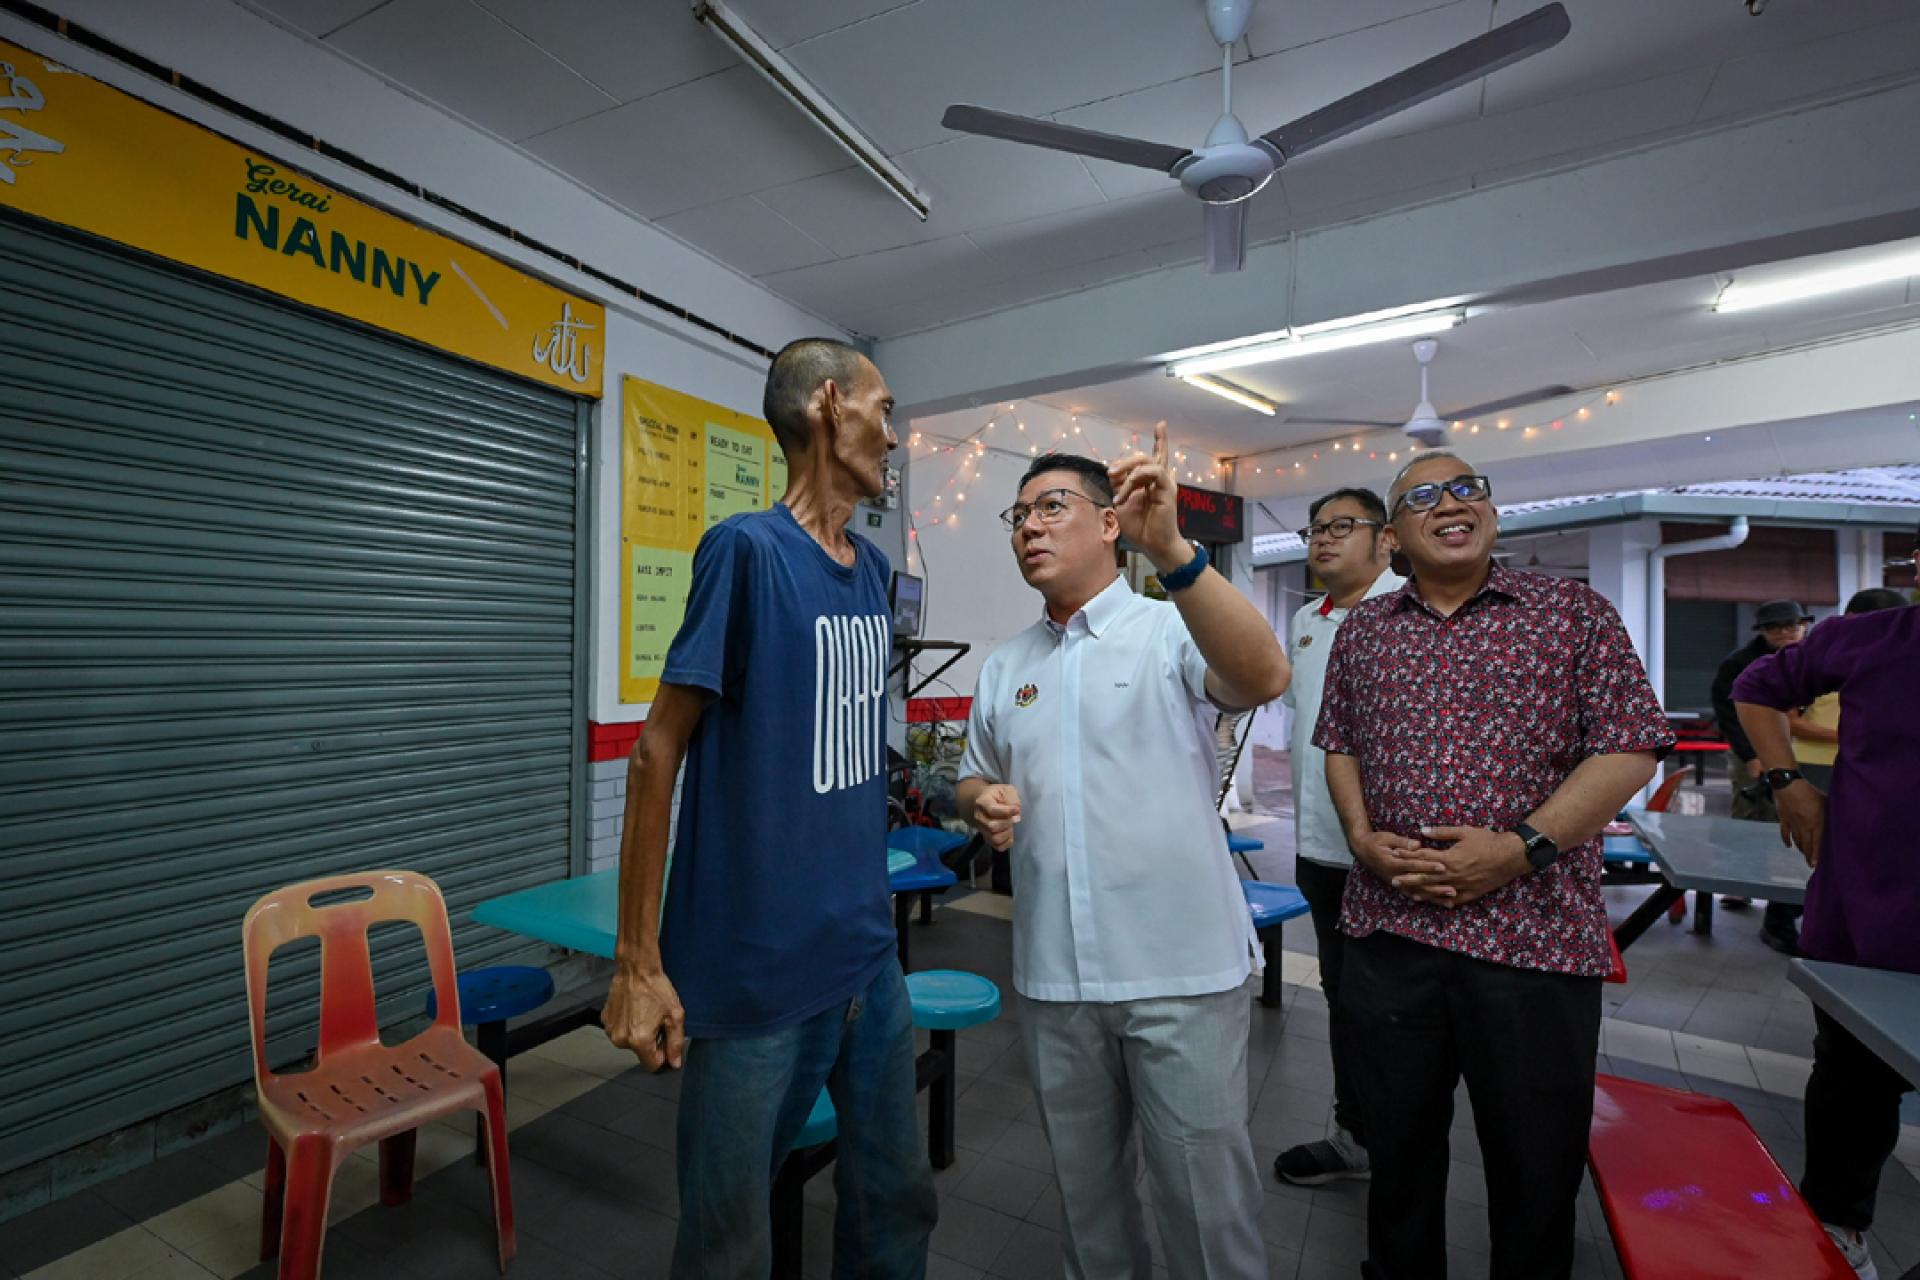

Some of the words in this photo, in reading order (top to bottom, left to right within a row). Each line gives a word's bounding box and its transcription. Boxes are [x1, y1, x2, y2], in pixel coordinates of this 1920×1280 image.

[245, 157, 332, 213] Gerai
[235, 192, 442, 305] NANNY
[710, 436, 730, 449] READY
[732, 442, 740, 453] TO
[741, 444, 753, 456] EAT
[814, 614, 888, 794] OKAY
